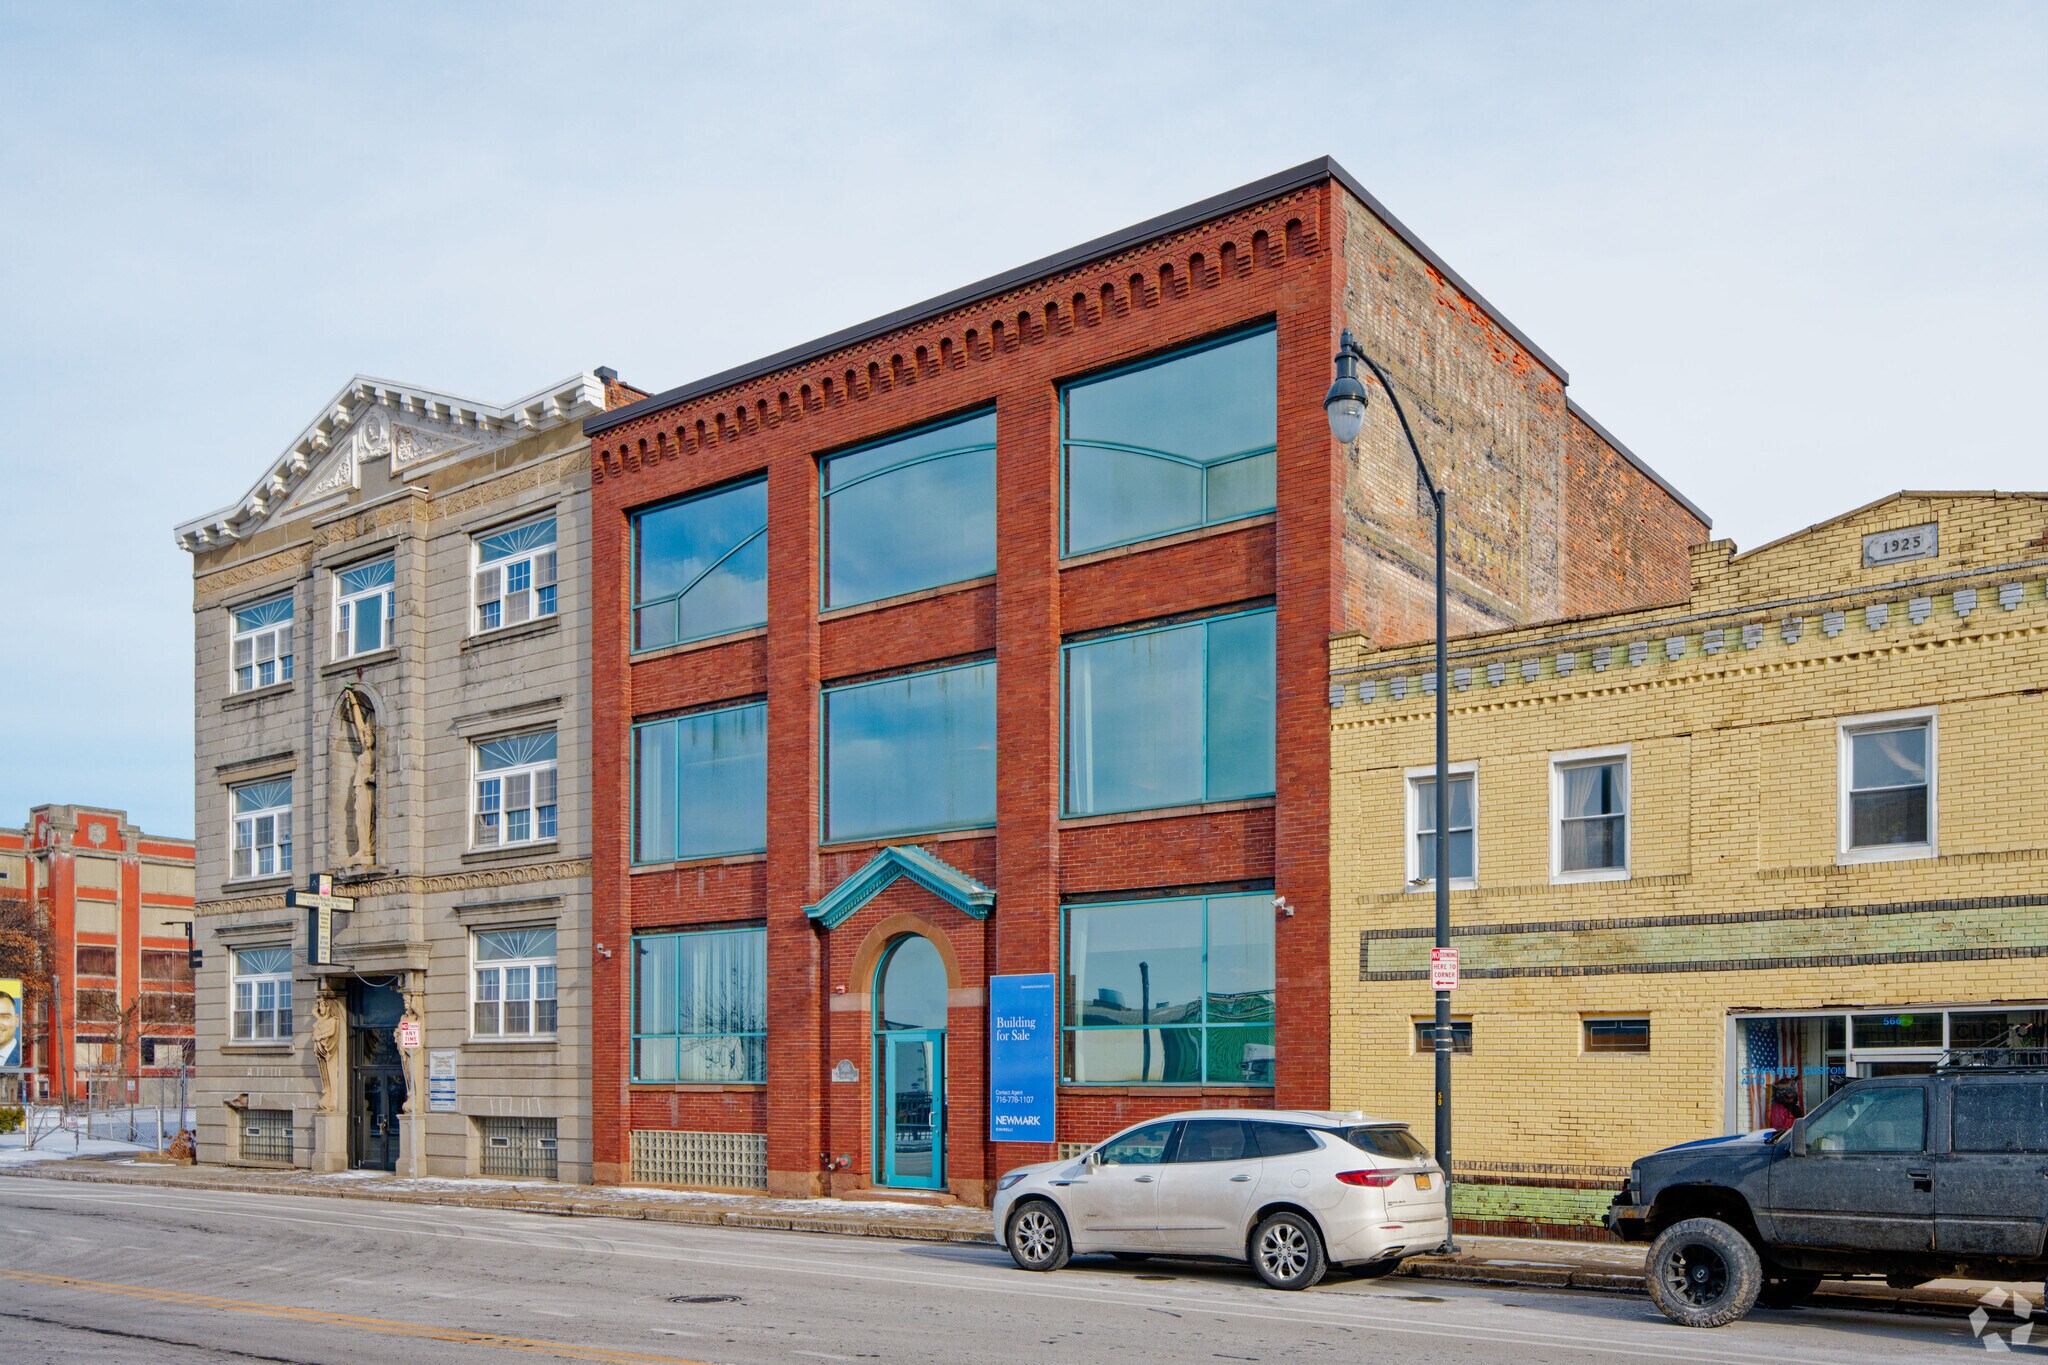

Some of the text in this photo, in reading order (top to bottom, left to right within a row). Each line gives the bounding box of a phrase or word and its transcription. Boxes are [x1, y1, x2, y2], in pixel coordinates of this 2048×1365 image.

[1883, 536, 1921, 554] 1925
[1432, 951, 1440, 959] NO
[996, 1016, 1036, 1029] Building
[996, 1029, 1030, 1041] for Sale
[1741, 1066, 1847, 1075] COMPLETE CUSTOM
[1741, 1077, 1766, 1085] AUTO
[995, 1115, 1041, 1126] NEWMARK
